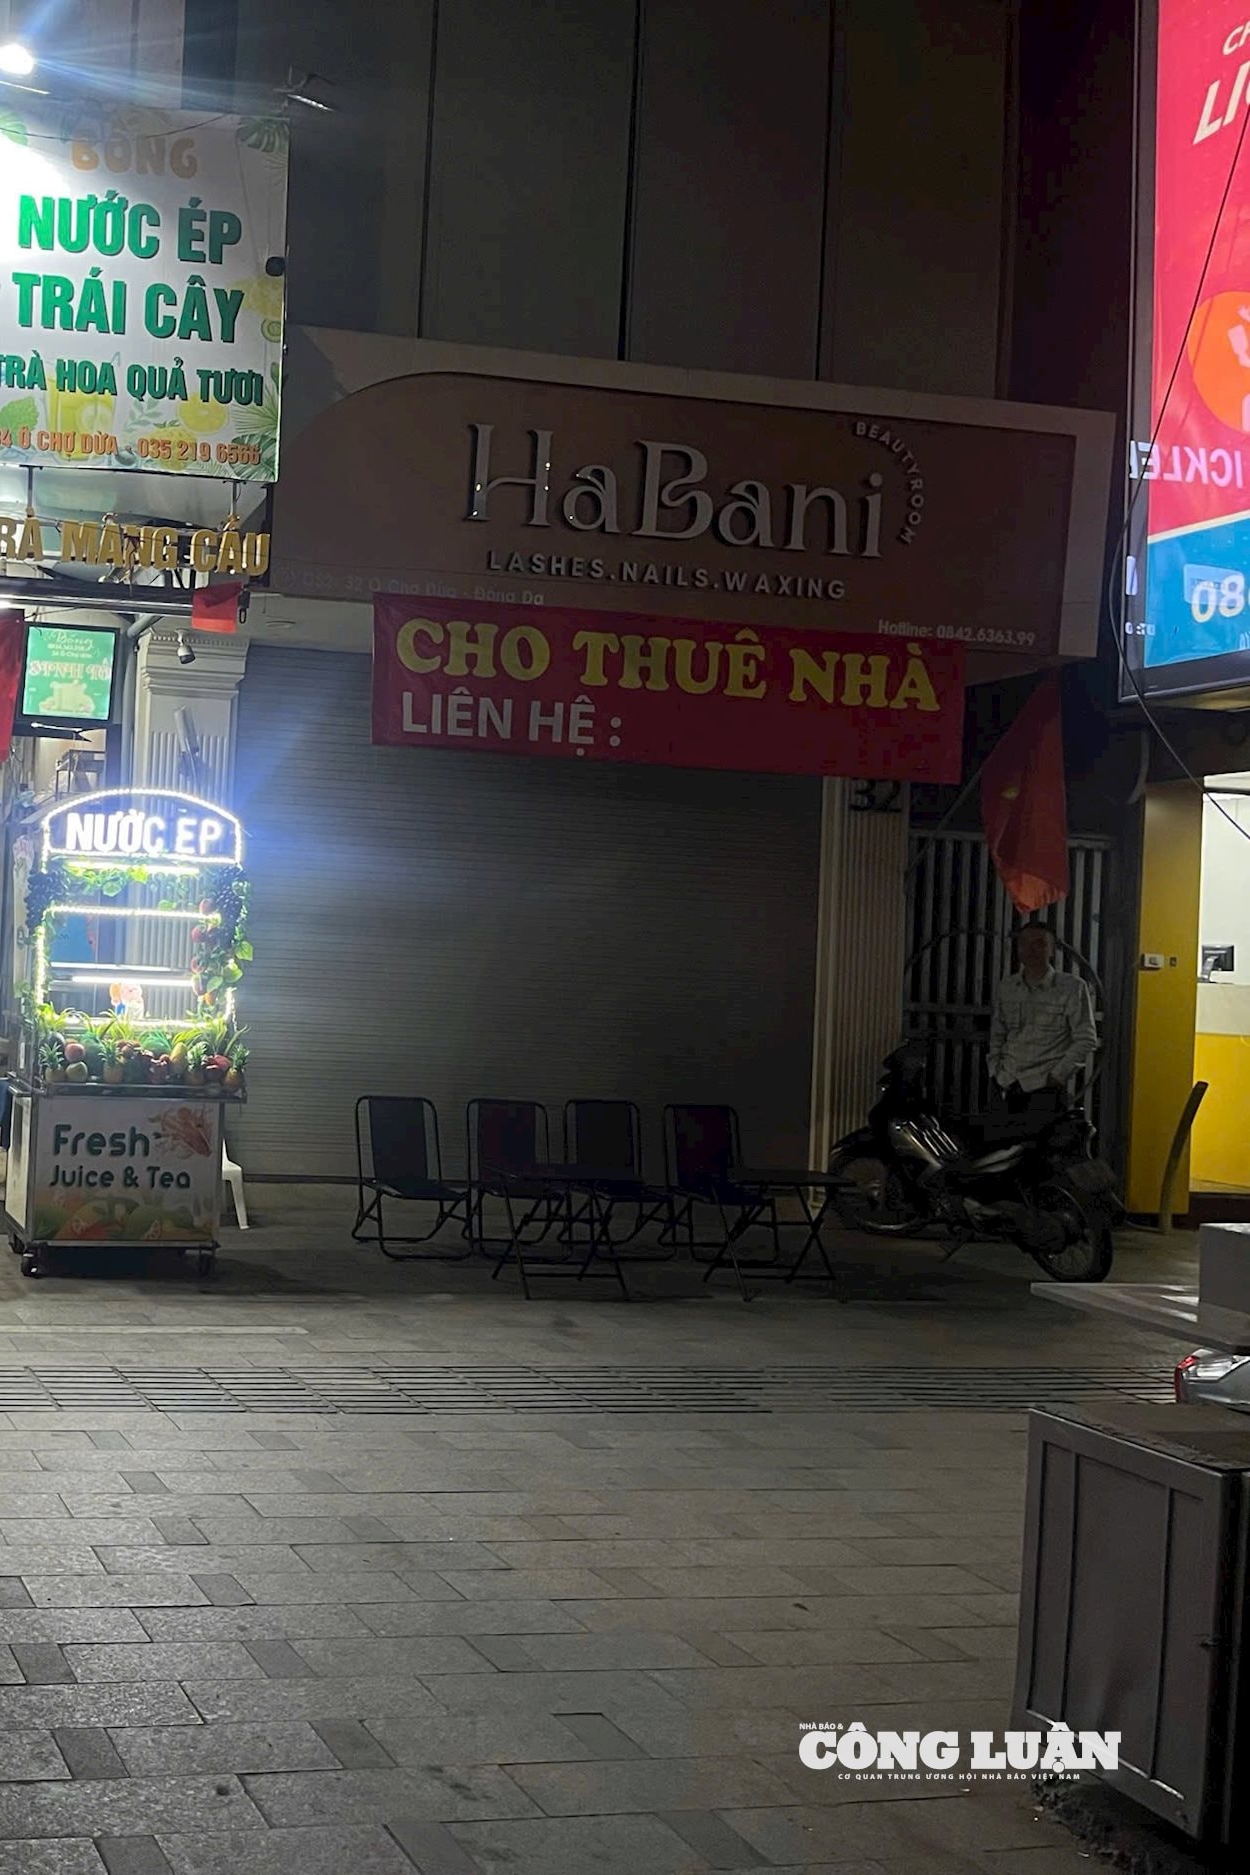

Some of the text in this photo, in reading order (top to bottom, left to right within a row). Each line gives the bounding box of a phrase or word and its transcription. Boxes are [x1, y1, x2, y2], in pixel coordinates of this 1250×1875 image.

[18, 189, 243, 264] NƯỚC ÉP
[11, 267, 246, 344] TRÁI CÂY
[56, 359, 117, 396] HOA
[126, 355, 188, 403] QUẢ
[196, 367, 264, 407] TƯƠI
[37, 431, 76, 458] CHỢ
[136, 438, 172, 459] 035
[177, 440, 211, 462] 219
[465, 423, 884, 559] HaBani
[878, 618, 933, 638] Hotline:
[395, 617, 941, 712] CHO THUÊ NHÀ
[401, 686, 512, 739] LIÊN
[53, 1124, 150, 1157] Fresh
[50, 1164, 191, 1188] Juice & Tea
